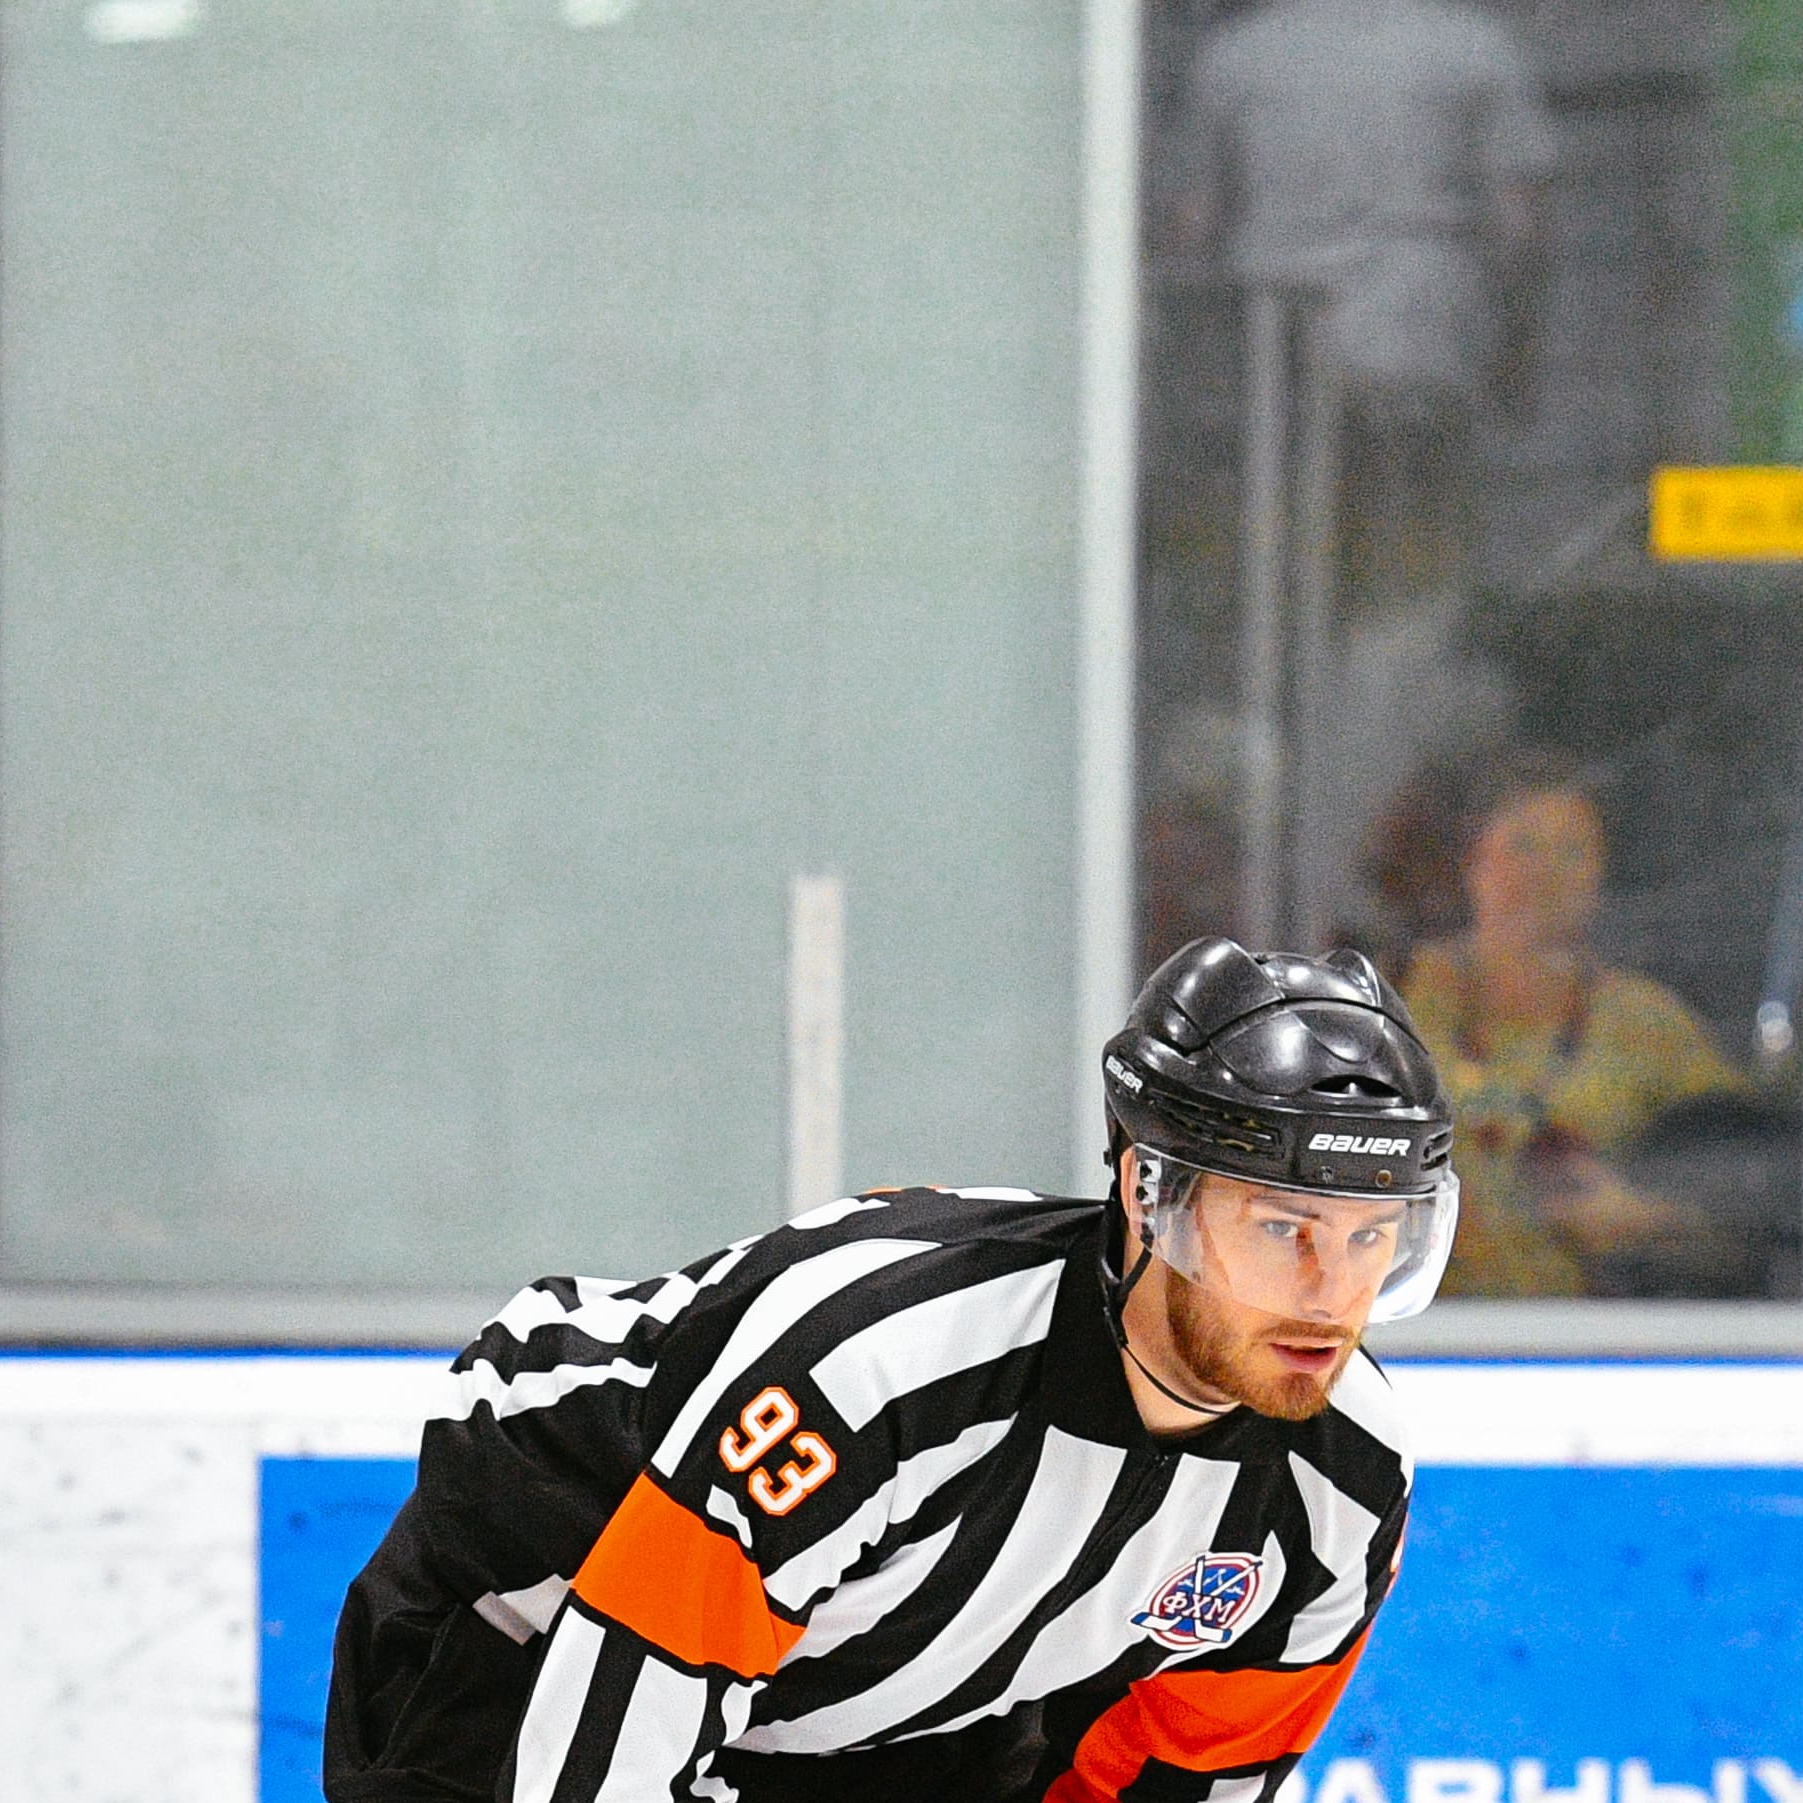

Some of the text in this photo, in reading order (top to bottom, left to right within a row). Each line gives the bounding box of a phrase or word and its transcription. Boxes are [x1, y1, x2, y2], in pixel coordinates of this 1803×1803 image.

[1308, 1133, 1411, 1157] BAUER
[718, 1385, 838, 1517] 93
[1161, 1590, 1236, 1624] ФХМ
